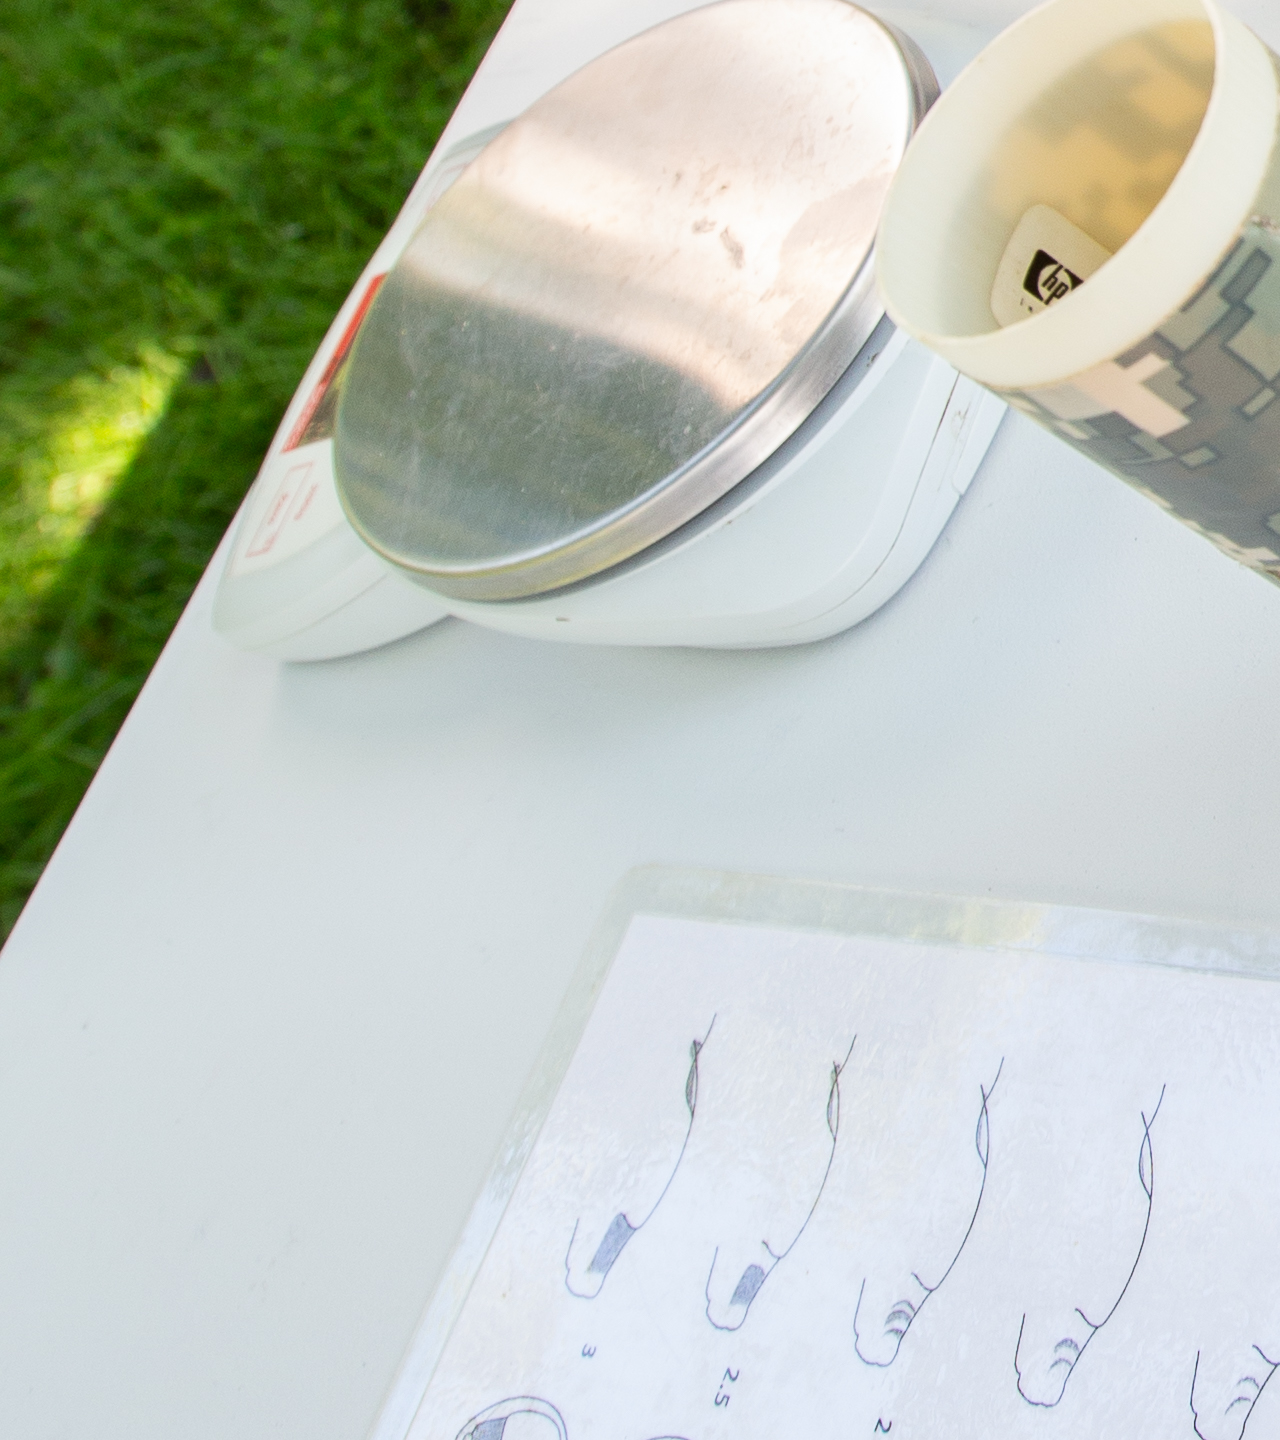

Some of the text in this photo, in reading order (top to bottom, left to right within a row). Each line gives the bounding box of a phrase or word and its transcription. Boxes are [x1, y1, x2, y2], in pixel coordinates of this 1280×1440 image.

[1041, 264, 1070, 305] hp
[713, 1367, 740, 1408] 2.5
[873, 1417, 893, 1434] 2
